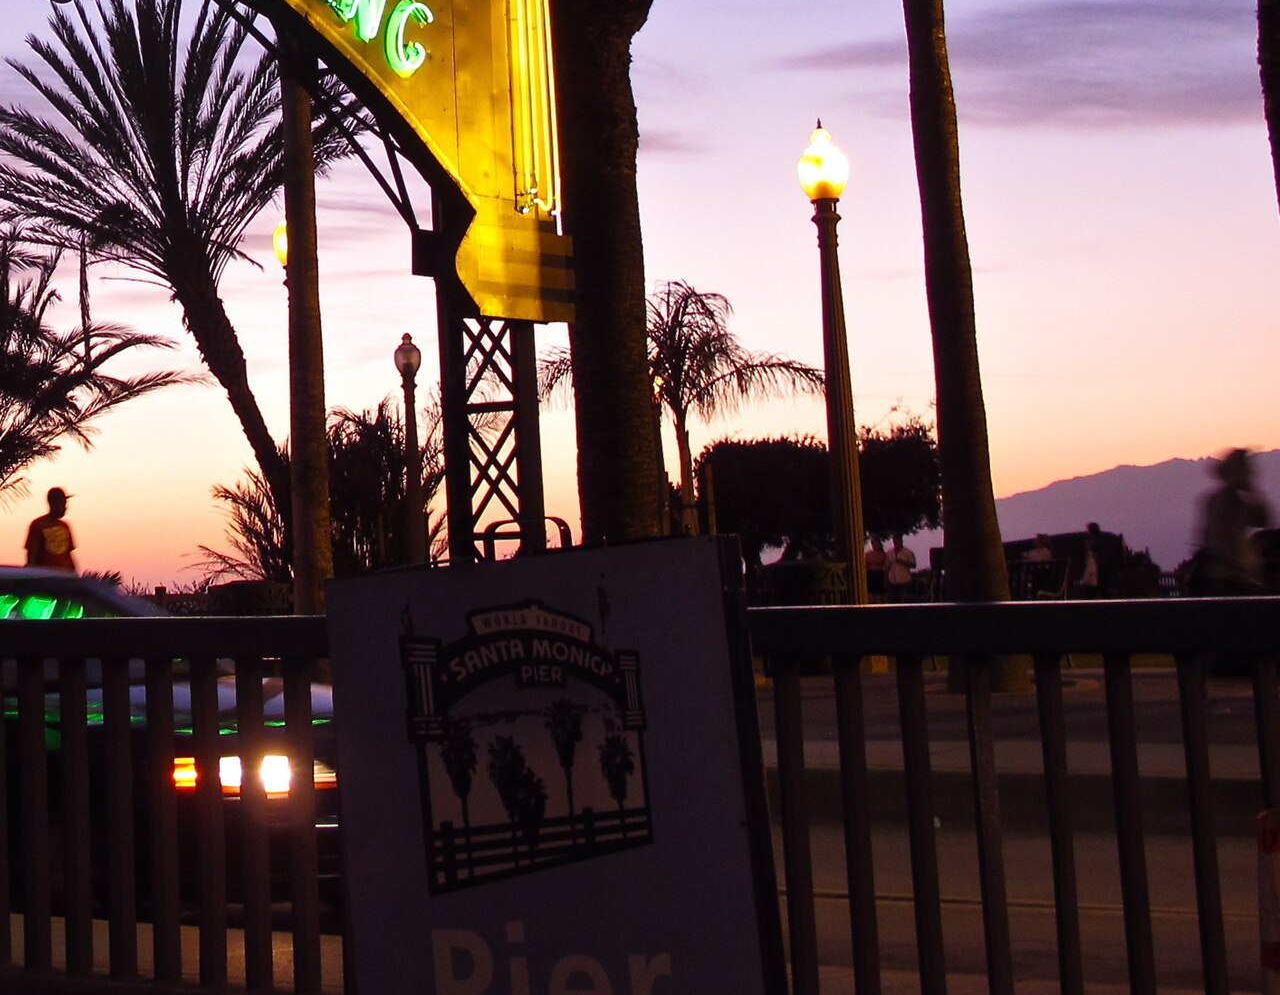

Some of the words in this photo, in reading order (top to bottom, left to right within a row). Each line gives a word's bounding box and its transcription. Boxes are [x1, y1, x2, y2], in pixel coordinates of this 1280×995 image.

[449, 638, 525, 682] SANTA
[532, 637, 614, 677] MONICA
[521, 664, 563, 684] PIER
[431, 920, 671, 995] Pier
